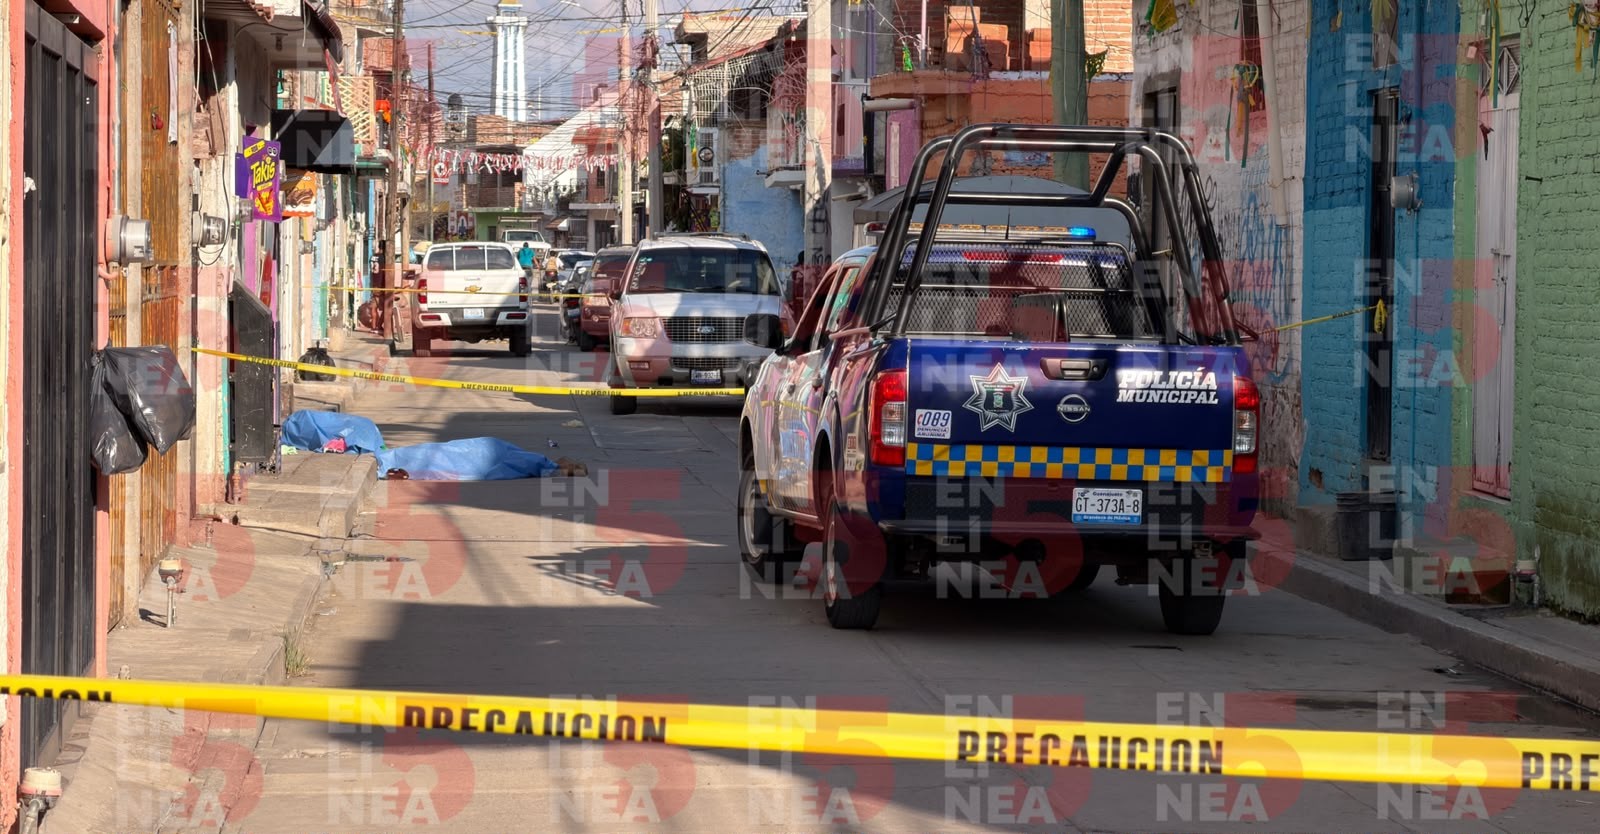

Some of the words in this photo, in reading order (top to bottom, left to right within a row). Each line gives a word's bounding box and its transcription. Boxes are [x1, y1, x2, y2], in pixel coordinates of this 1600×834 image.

[251, 157, 276, 189] Takis
[1118, 367, 1217, 389] POLICÍA
[1117, 390, 1218, 404] MUNICIPAL
[922, 411, 950, 427] 089
[1075, 498, 1139, 513] GT-373A-8
[958, 730, 1223, 774] PRECAUCION
